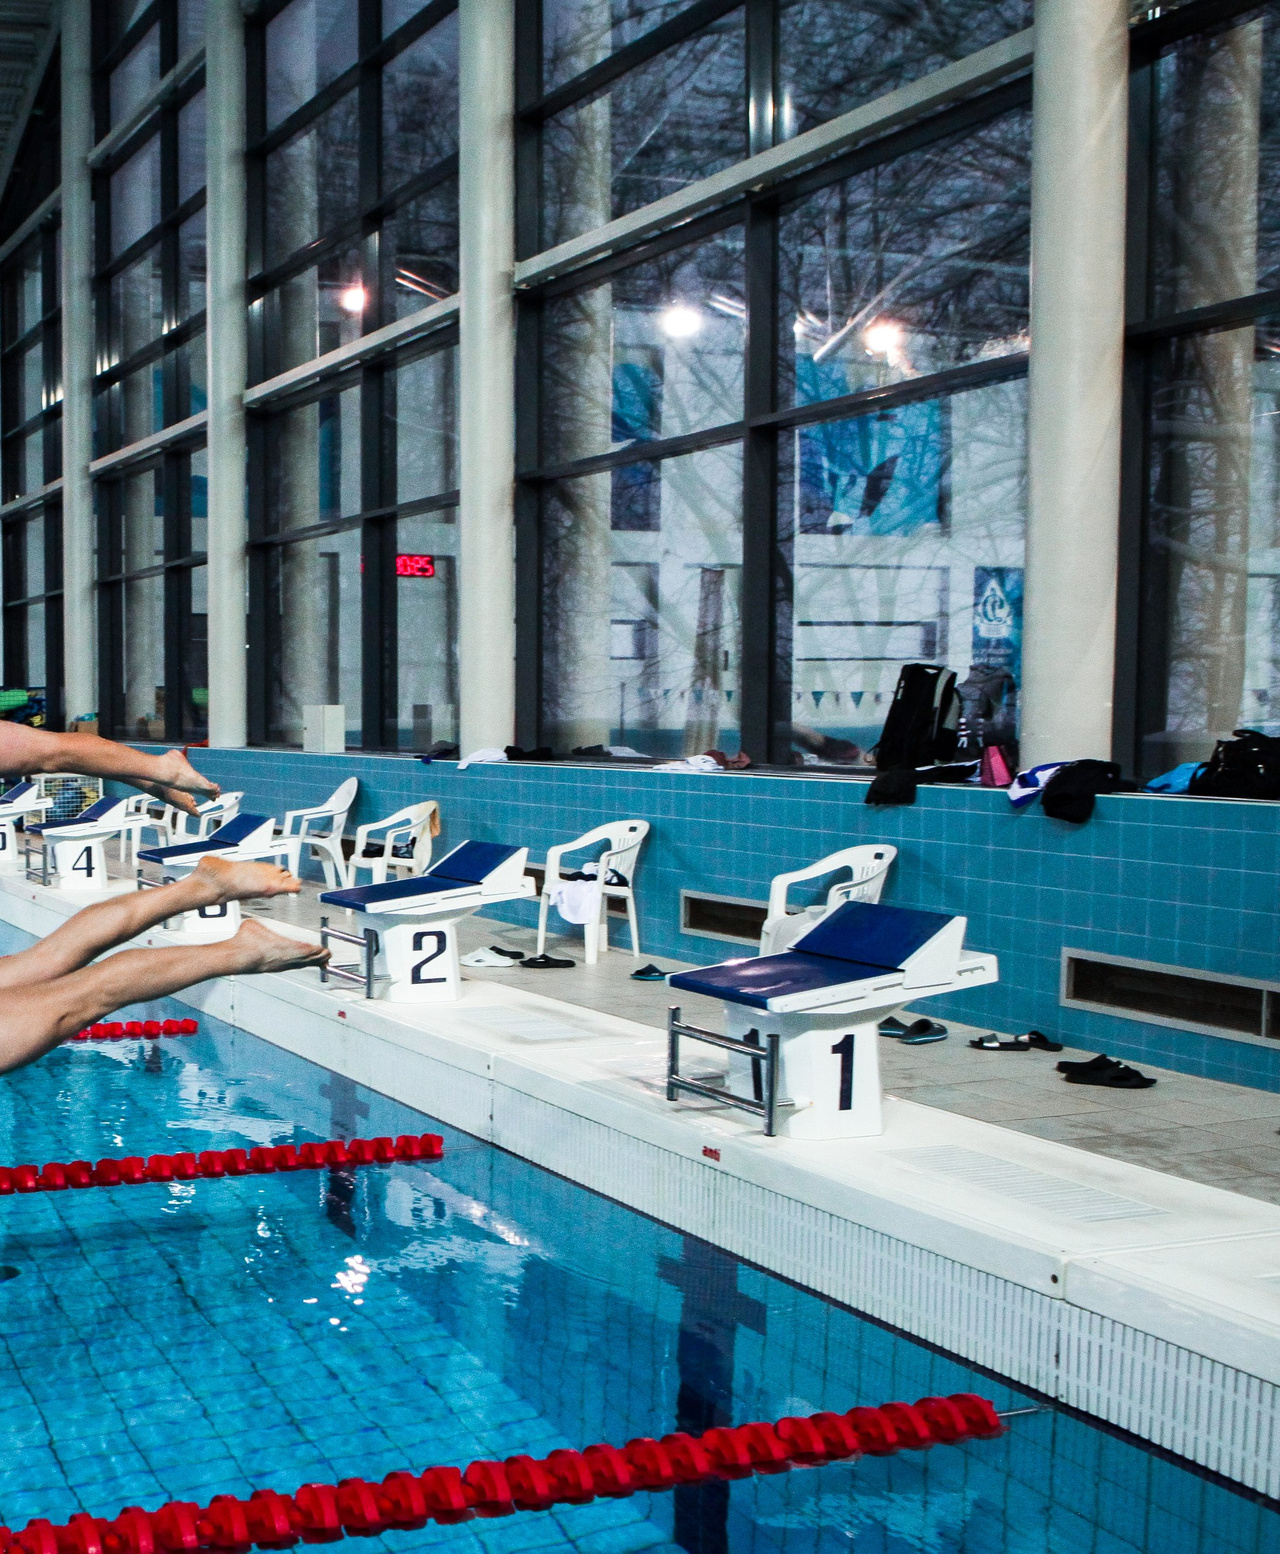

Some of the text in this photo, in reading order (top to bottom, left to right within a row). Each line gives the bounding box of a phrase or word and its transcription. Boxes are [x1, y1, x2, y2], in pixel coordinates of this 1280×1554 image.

[71, 846, 96, 878] 4
[411, 930, 447, 984] 2
[742, 1027, 763, 1102] 1
[831, 1034, 855, 1111] 1
